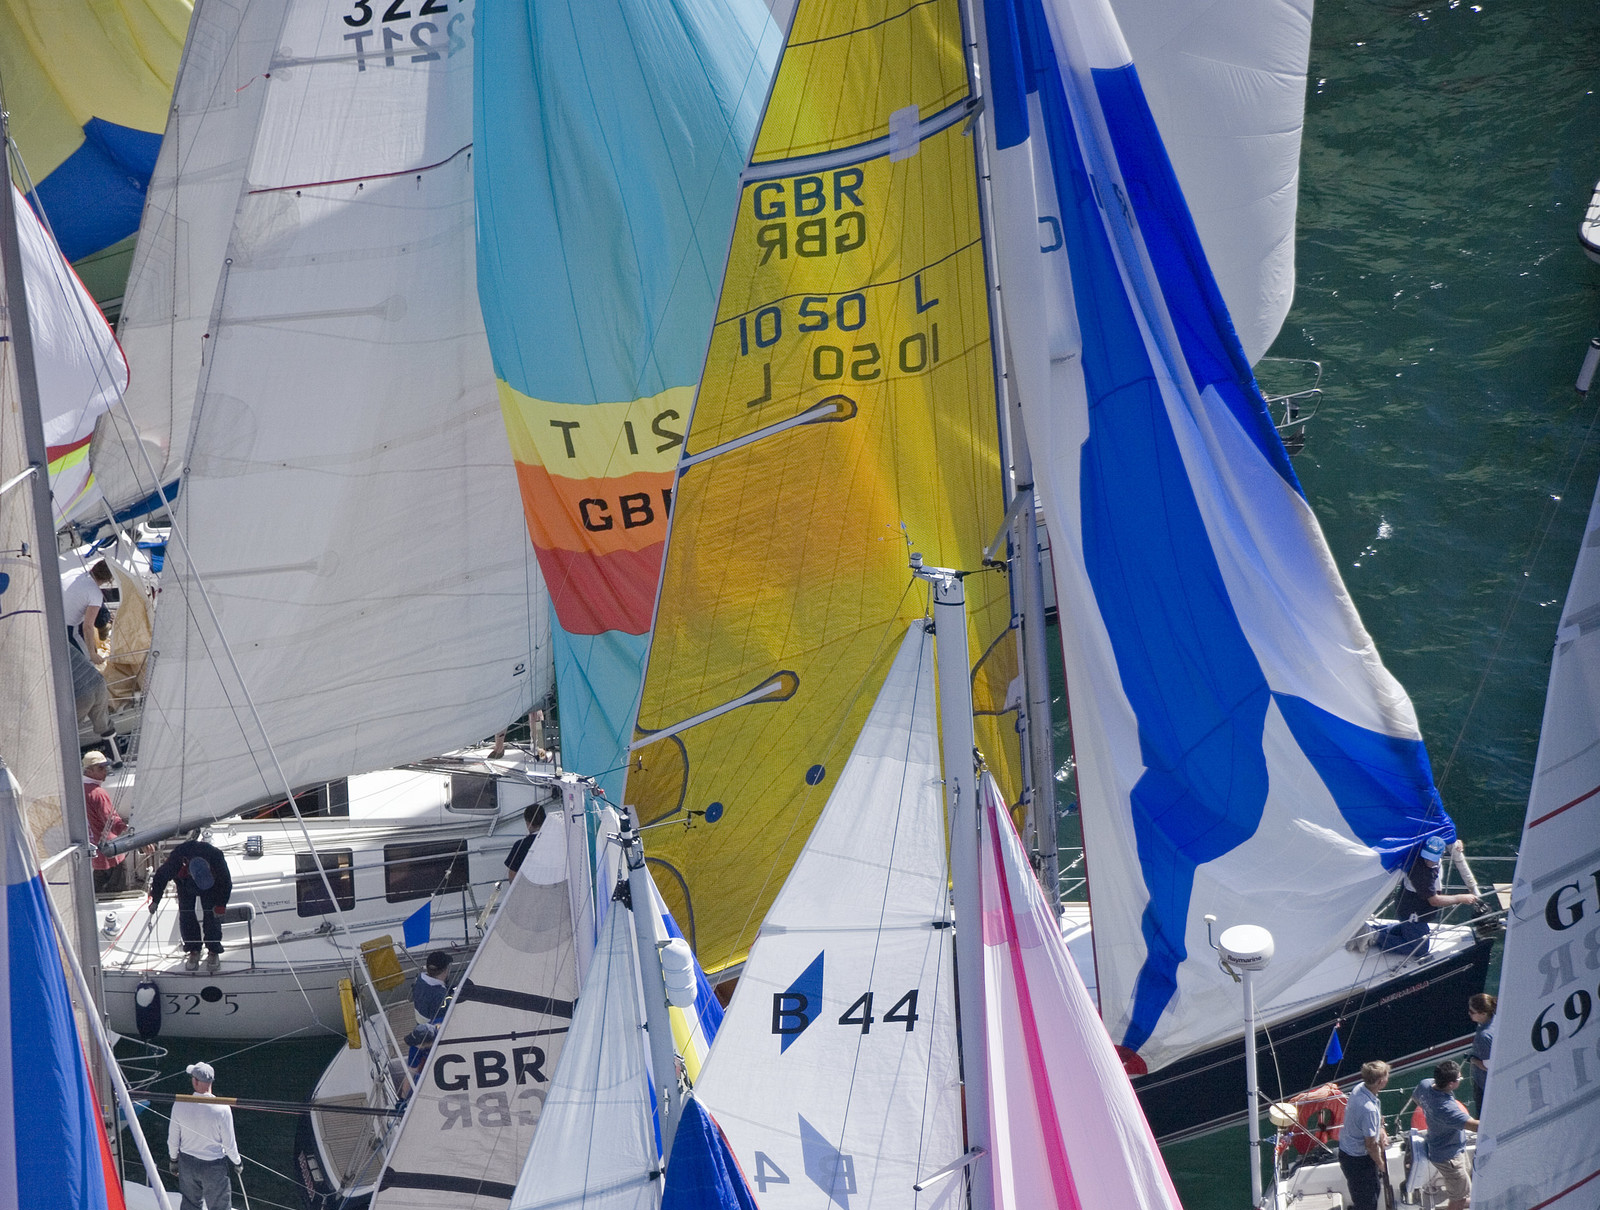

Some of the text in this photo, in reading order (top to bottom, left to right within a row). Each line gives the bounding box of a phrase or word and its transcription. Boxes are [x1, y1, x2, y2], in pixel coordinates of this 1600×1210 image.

[754, 168, 864, 220] GBR
[1227, 955, 1262, 963] Raymarine
[771, 989, 919, 1035] B 44
[433, 1046, 549, 1091] GBR
